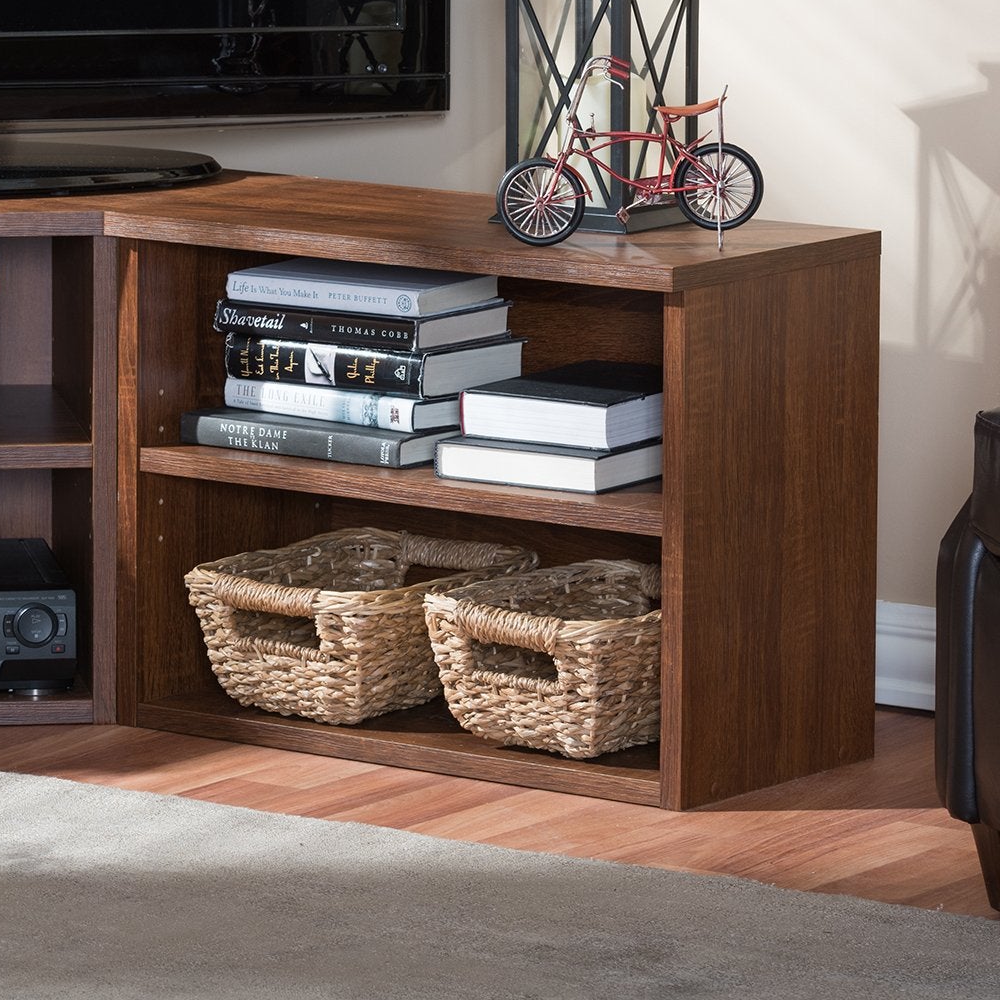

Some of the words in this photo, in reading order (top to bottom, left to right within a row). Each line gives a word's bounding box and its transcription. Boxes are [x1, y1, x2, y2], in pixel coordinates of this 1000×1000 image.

[232, 280, 249, 294] Life
[251, 284, 257, 293] Is
[259, 286, 278, 296] What
[279, 287, 292, 297] You
[293, 289, 311, 298] Make
[312, 290, 319, 299] It
[328, 292, 351, 300] PETER
[354, 295, 388, 304] BUFFETT
[222, 308, 286, 330] Shavetail
[331, 324, 376, 336] THOMAS
[382, 330, 408, 340] COBB
[236, 384, 257, 397] THE
[220, 423, 255, 436] NOTRE
[258, 428, 288, 440] DAME
[228, 436, 248, 447] THE
[251, 439, 280, 450] KLAN
